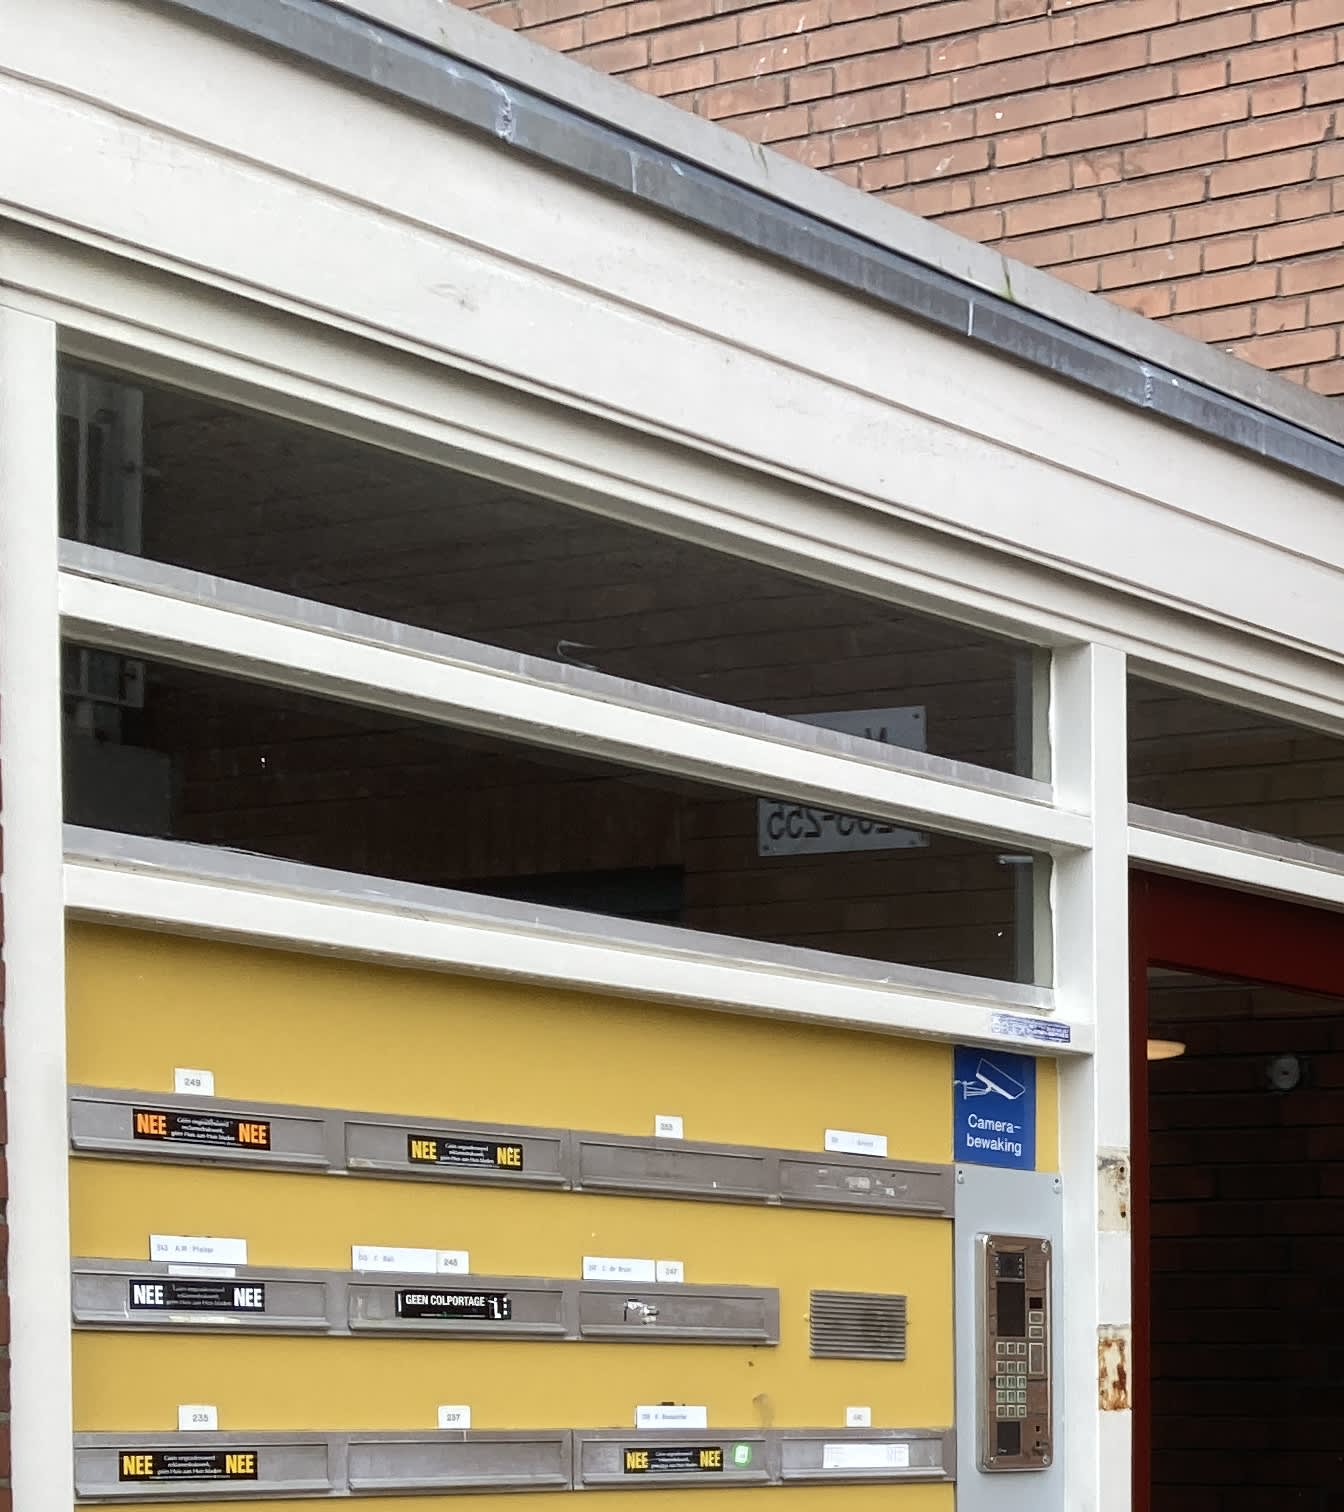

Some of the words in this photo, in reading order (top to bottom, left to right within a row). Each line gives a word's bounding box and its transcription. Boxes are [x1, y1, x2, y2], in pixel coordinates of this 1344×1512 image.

[136, 1113, 167, 1135] NEE
[967, 1113, 1022, 1133] Camera-
[239, 1123, 267, 1144] NEE
[411, 1140, 437, 1160] NEE
[966, 1133, 1022, 1157] bewaking
[496, 1147, 520, 1166] NEE
[133, 1284, 163, 1304] NEE
[233, 1287, 263, 1307] NEE
[405, 1294, 429, 1305] GEEN
[430, 1295, 486, 1307] COLPORTAGE
[123, 1455, 153, 1475] NEE
[225, 1454, 254, 1474] NEE
[626, 1451, 649, 1469] NEE
[700, 1450, 720, 1468] NEE
